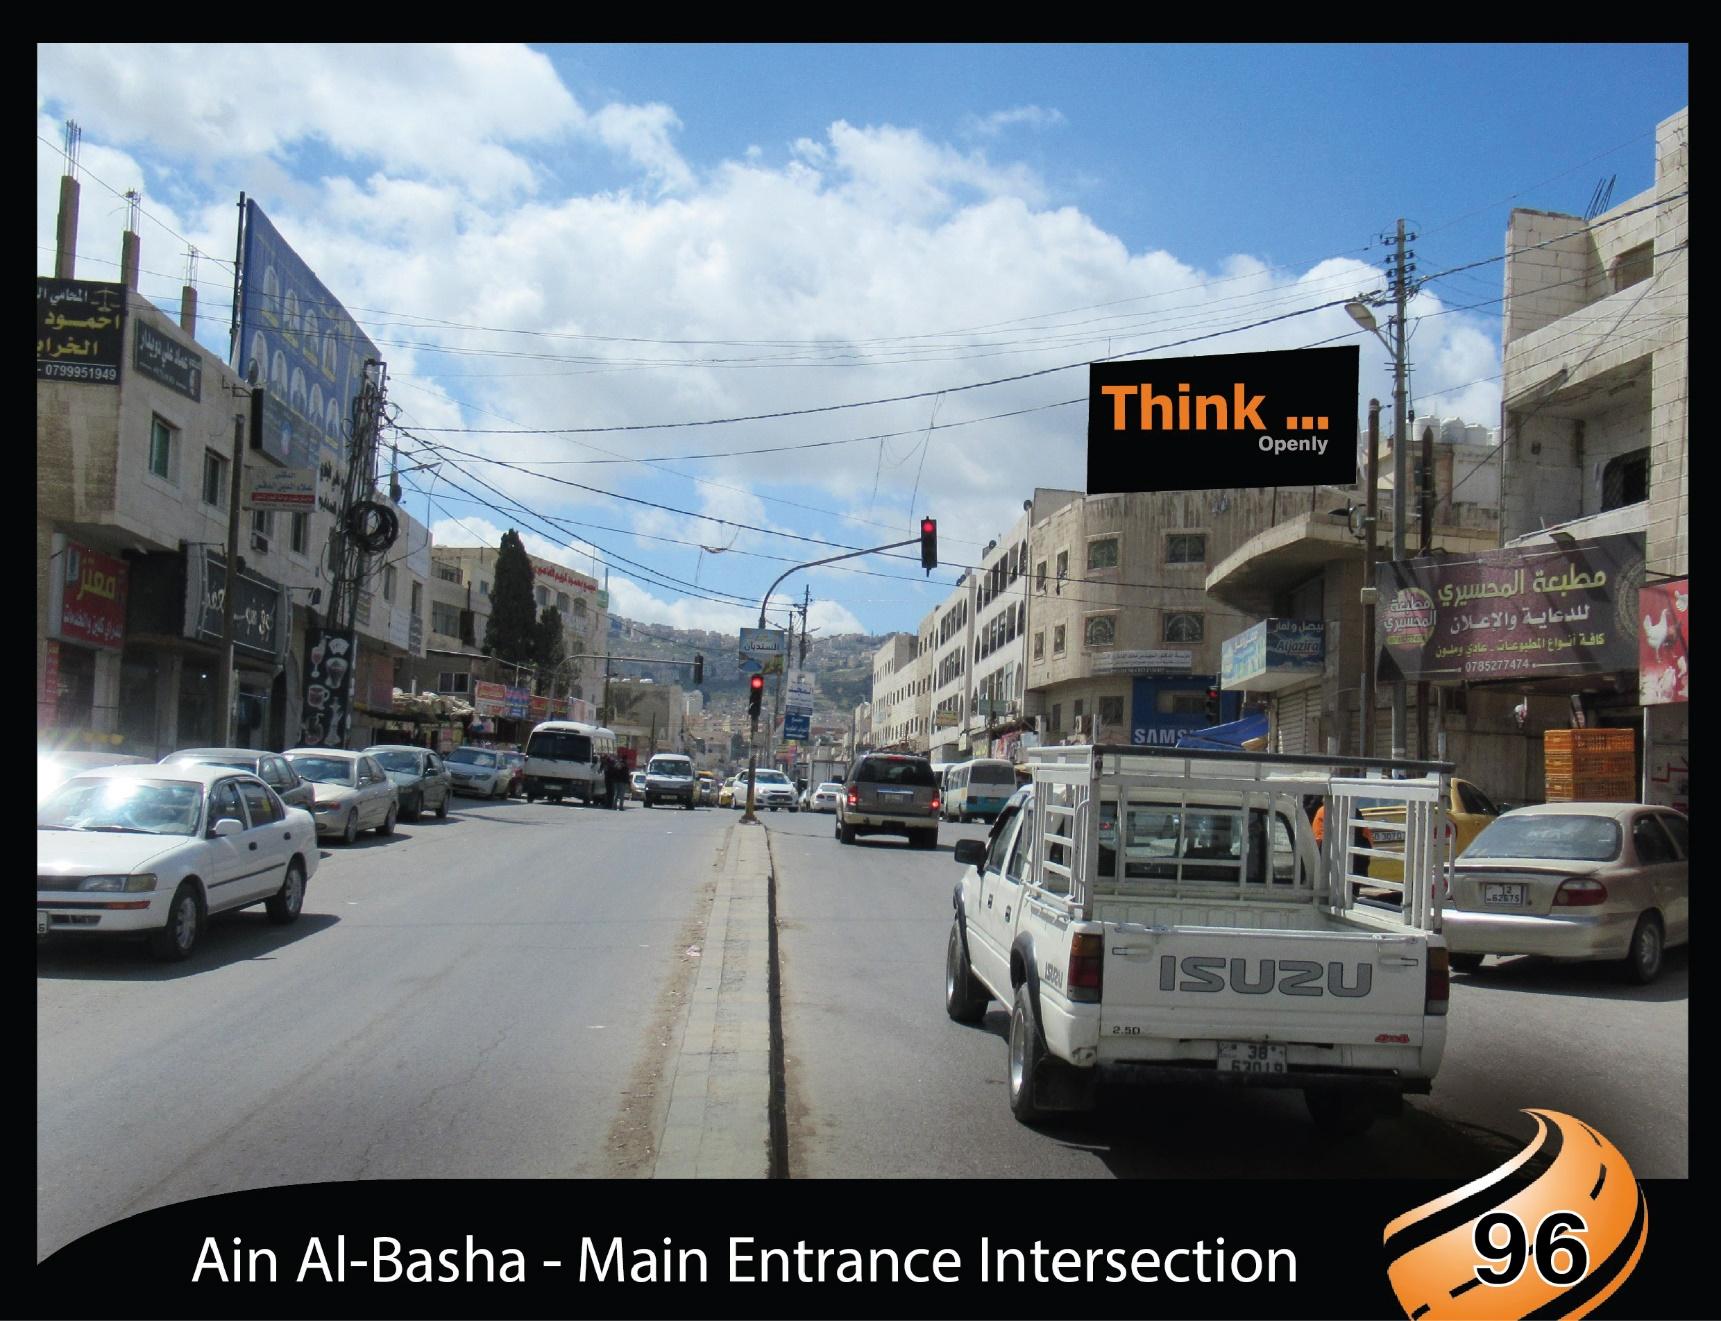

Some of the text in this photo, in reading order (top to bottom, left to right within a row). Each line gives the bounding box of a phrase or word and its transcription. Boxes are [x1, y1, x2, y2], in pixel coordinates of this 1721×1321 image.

[45, 364, 117, 381] 0799951949
[1101, 383, 1267, 430] Think
[1258, 435, 1329, 456] Openly
[1532, 563, 1607, 597] مطبعة
[1390, 595, 1430, 615] مطبعة
[1521, 603, 1590, 629] للدعاية
[1578, 632, 1606, 646] كافة
[1465, 659, 1530, 673] 0785277474
[1134, 728, 1190, 744] SAMS
[1159, 955, 1372, 998] ISUZU
[1247, 1045, 1268, 1060] 38
